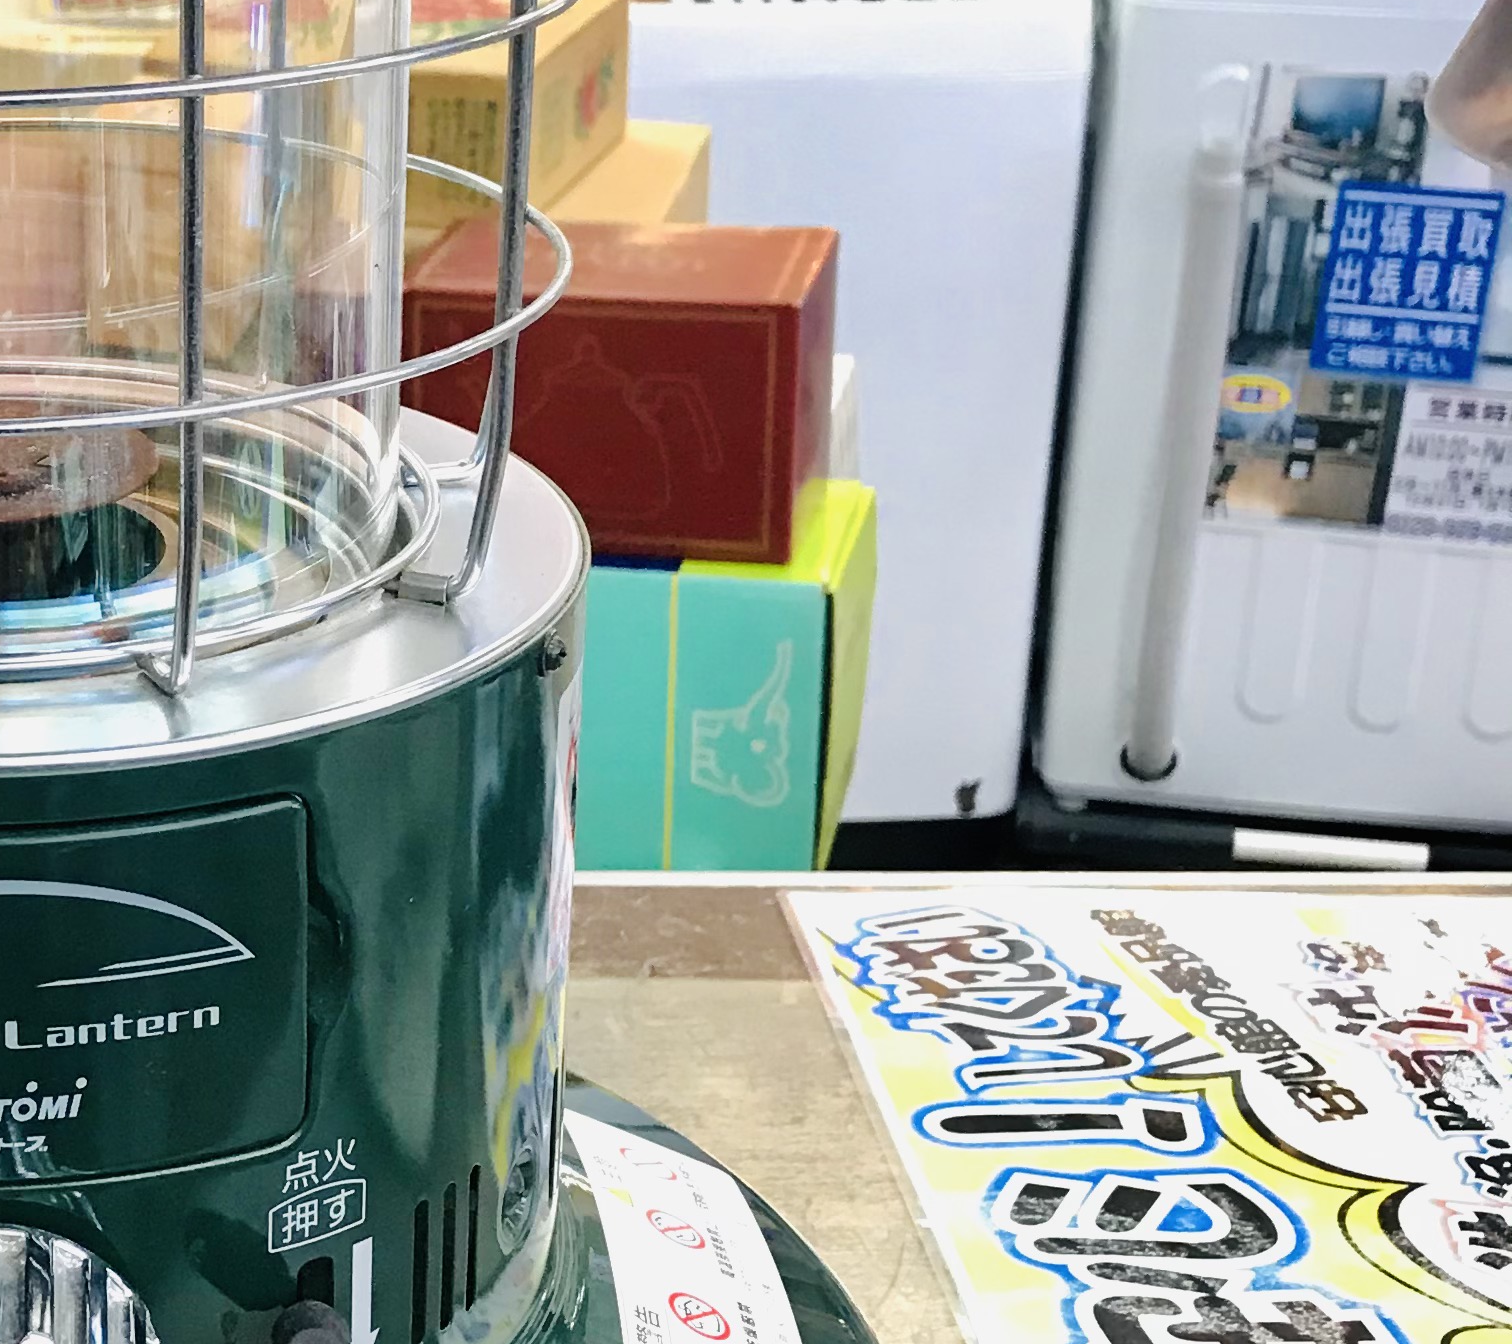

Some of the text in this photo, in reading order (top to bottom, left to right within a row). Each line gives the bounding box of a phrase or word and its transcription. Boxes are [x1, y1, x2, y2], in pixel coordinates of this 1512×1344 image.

[1339, 203, 1494, 259] 出張買取
[1329, 254, 1484, 312] 出張見積
[4, 1004, 222, 1050] Lantern
[281, 1137, 359, 1193] 点火
[281, 1186, 357, 1242] 押す
